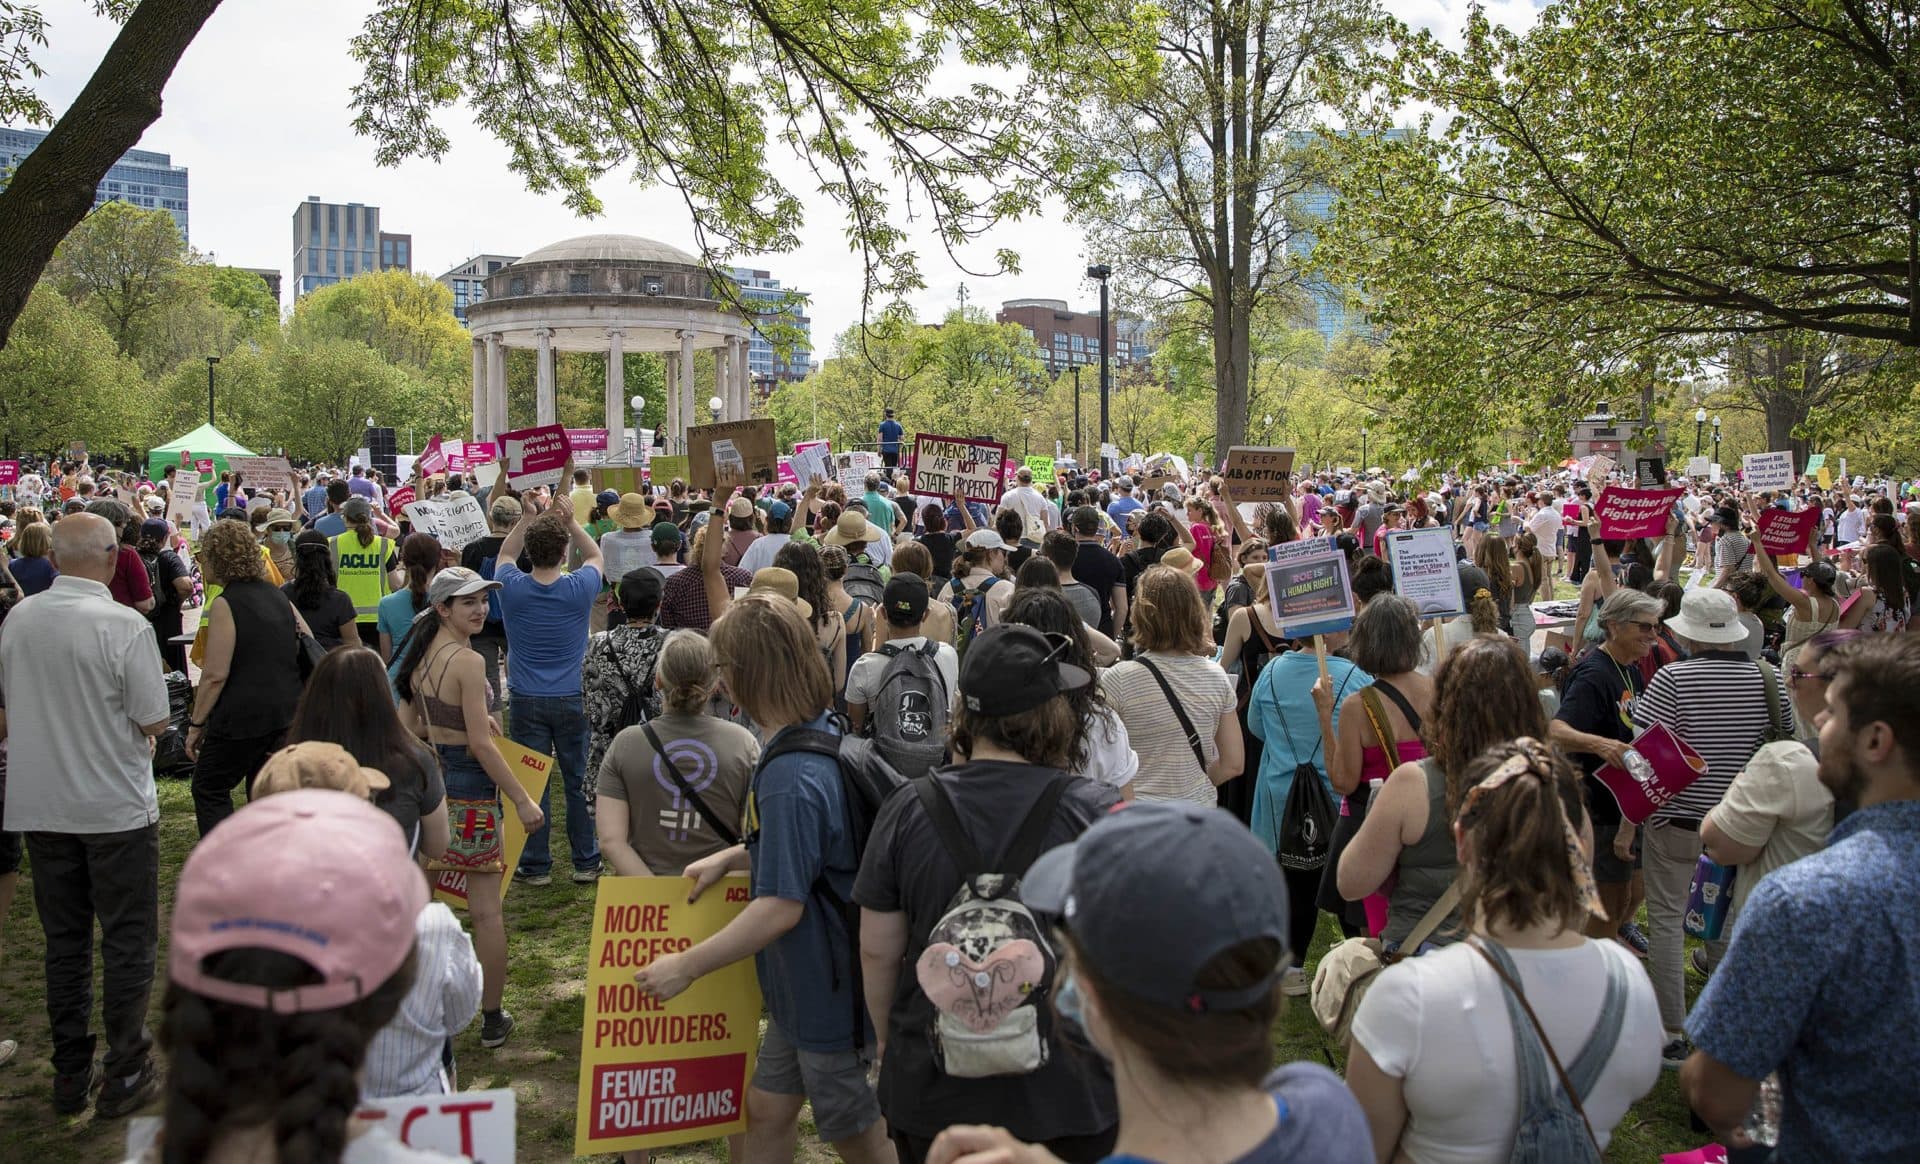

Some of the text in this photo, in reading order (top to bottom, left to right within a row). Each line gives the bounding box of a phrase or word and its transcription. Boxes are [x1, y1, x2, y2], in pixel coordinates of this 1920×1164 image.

[545, 432, 560, 441] We
[521, 442, 562, 458] ght for All
[968, 445, 1001, 466] BODIES
[933, 457, 953, 472] ARE
[957, 460, 978, 475] NOT
[1240, 455, 1277, 464] KEEP
[1751, 457, 1772, 466] Support
[1227, 468, 1290, 481] ABORTION
[917, 471, 998, 500] STATE PROPERTY
[1260, 487, 1283, 495] LEGAL
[1752, 480, 1785, 488] Moratorium
[446, 501, 477, 517] RIGHTS
[1606, 494, 1660, 508] Together
[1601, 507, 1636, 521] Fight
[1636, 510, 1652, 520] for
[455, 521, 483, 537] RIGHTS
[339, 554, 380, 568] ACLU
[339, 568, 379, 576] Massachusetts
[1292, 568, 1324, 584] ROE IS
[1402, 569, 1427, 577] Abortion
[1281, 588, 1287, 599] A
[1287, 582, 1312, 597] HUMAN
[521, 754, 546, 772] ACLU
[725, 887, 751, 902] ACL
[604, 904, 670, 934] MORE
[597, 983, 665, 1014] MORE
[595, 1012, 731, 1049] PROVIDERS.
[600, 1067, 676, 1100] FEWER
[599, 1088, 737, 1131] POLITICIANS.
